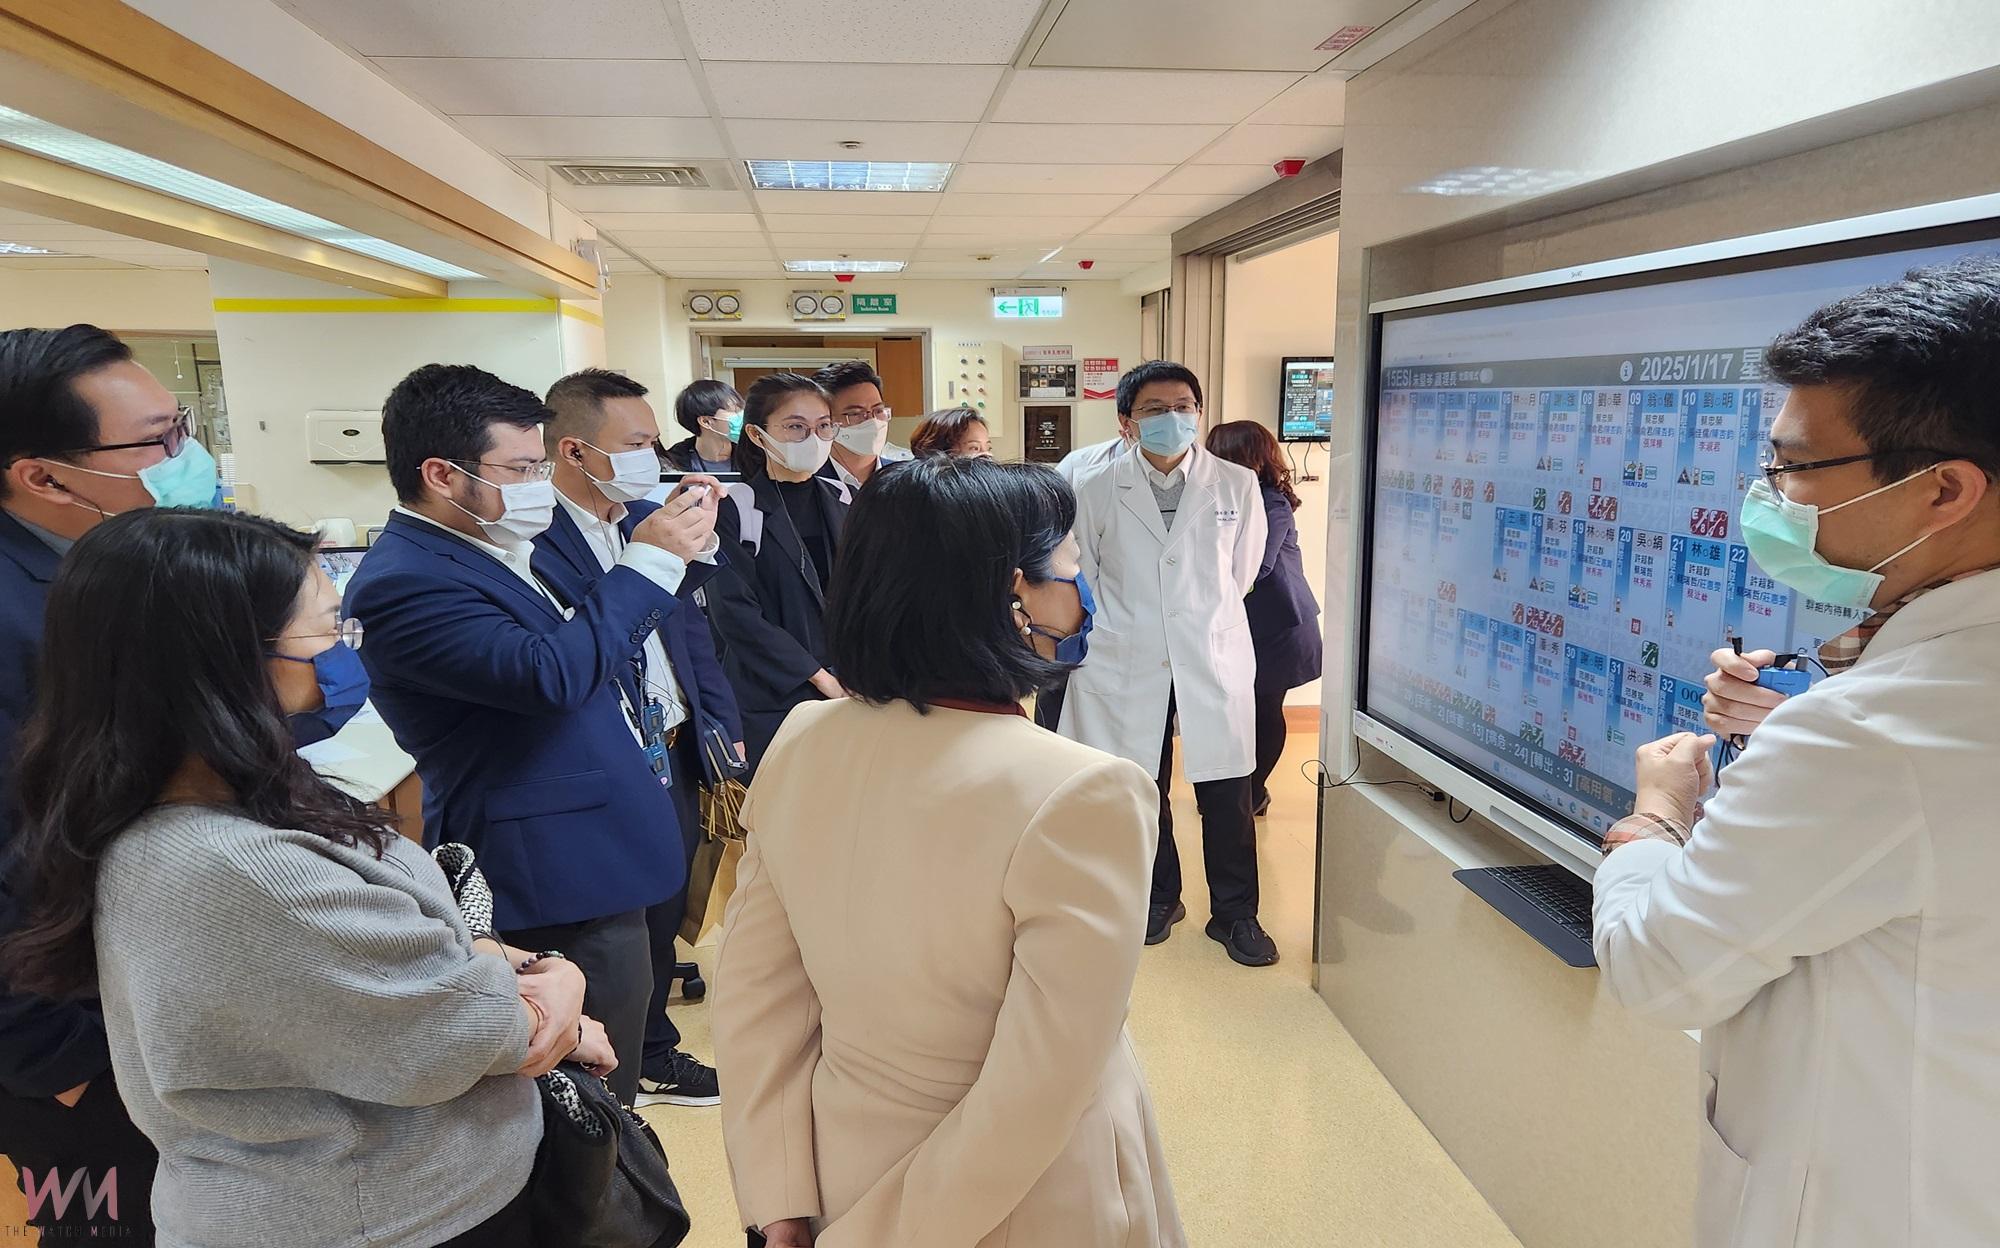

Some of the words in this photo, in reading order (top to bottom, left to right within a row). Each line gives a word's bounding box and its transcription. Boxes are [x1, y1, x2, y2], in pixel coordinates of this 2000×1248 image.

[1639, 353, 1734, 382] 2025/1/17
[1739, 348, 1763, 381] 星
[1582, 393, 1593, 405] 08
[1629, 392, 1642, 405] 09
[1683, 391, 1697, 406] 10
[1745, 391, 1759, 406] 11
[1574, 522, 1584, 535] 19
[1620, 529, 1632, 544] 20
[1672, 538, 1684, 553] 21
[1731, 548, 1746, 563] 22
[1526, 632, 1535, 645] 29
[1566, 646, 1576, 659] 30
[1610, 661, 1622, 675] 31
[1661, 678, 1674, 693] 32
